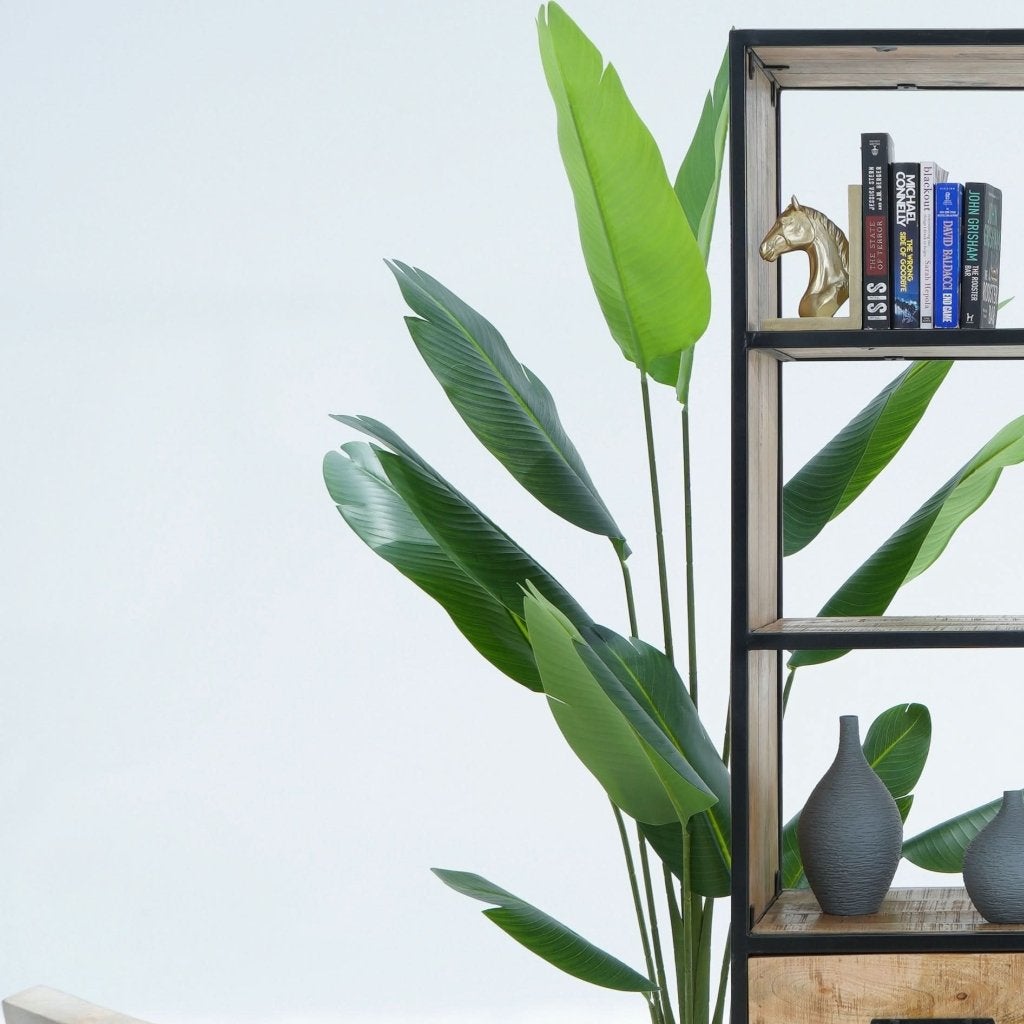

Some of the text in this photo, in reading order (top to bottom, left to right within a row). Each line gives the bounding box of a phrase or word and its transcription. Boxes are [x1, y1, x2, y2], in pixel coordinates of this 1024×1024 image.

[895, 171, 906, 227] CONNELLY
[906, 174, 916, 224] MICHAEL
[923, 166, 932, 211] blackout
[942, 220, 953, 246] DAVID
[966, 189, 980, 261] JOHN GRISHAM
[877, 259, 883, 270] OF
[899, 247, 906, 257] OF
[942, 249, 953, 290] BALDACCI
[899, 258, 907, 292] GOODBYE
[964, 265, 972, 277] BAR
[971, 265, 979, 301] THE ROOSTER
[867, 282, 887, 320] ISIS
[923, 282, 931, 309] Hepola
[942, 292, 952, 322] END GAME
